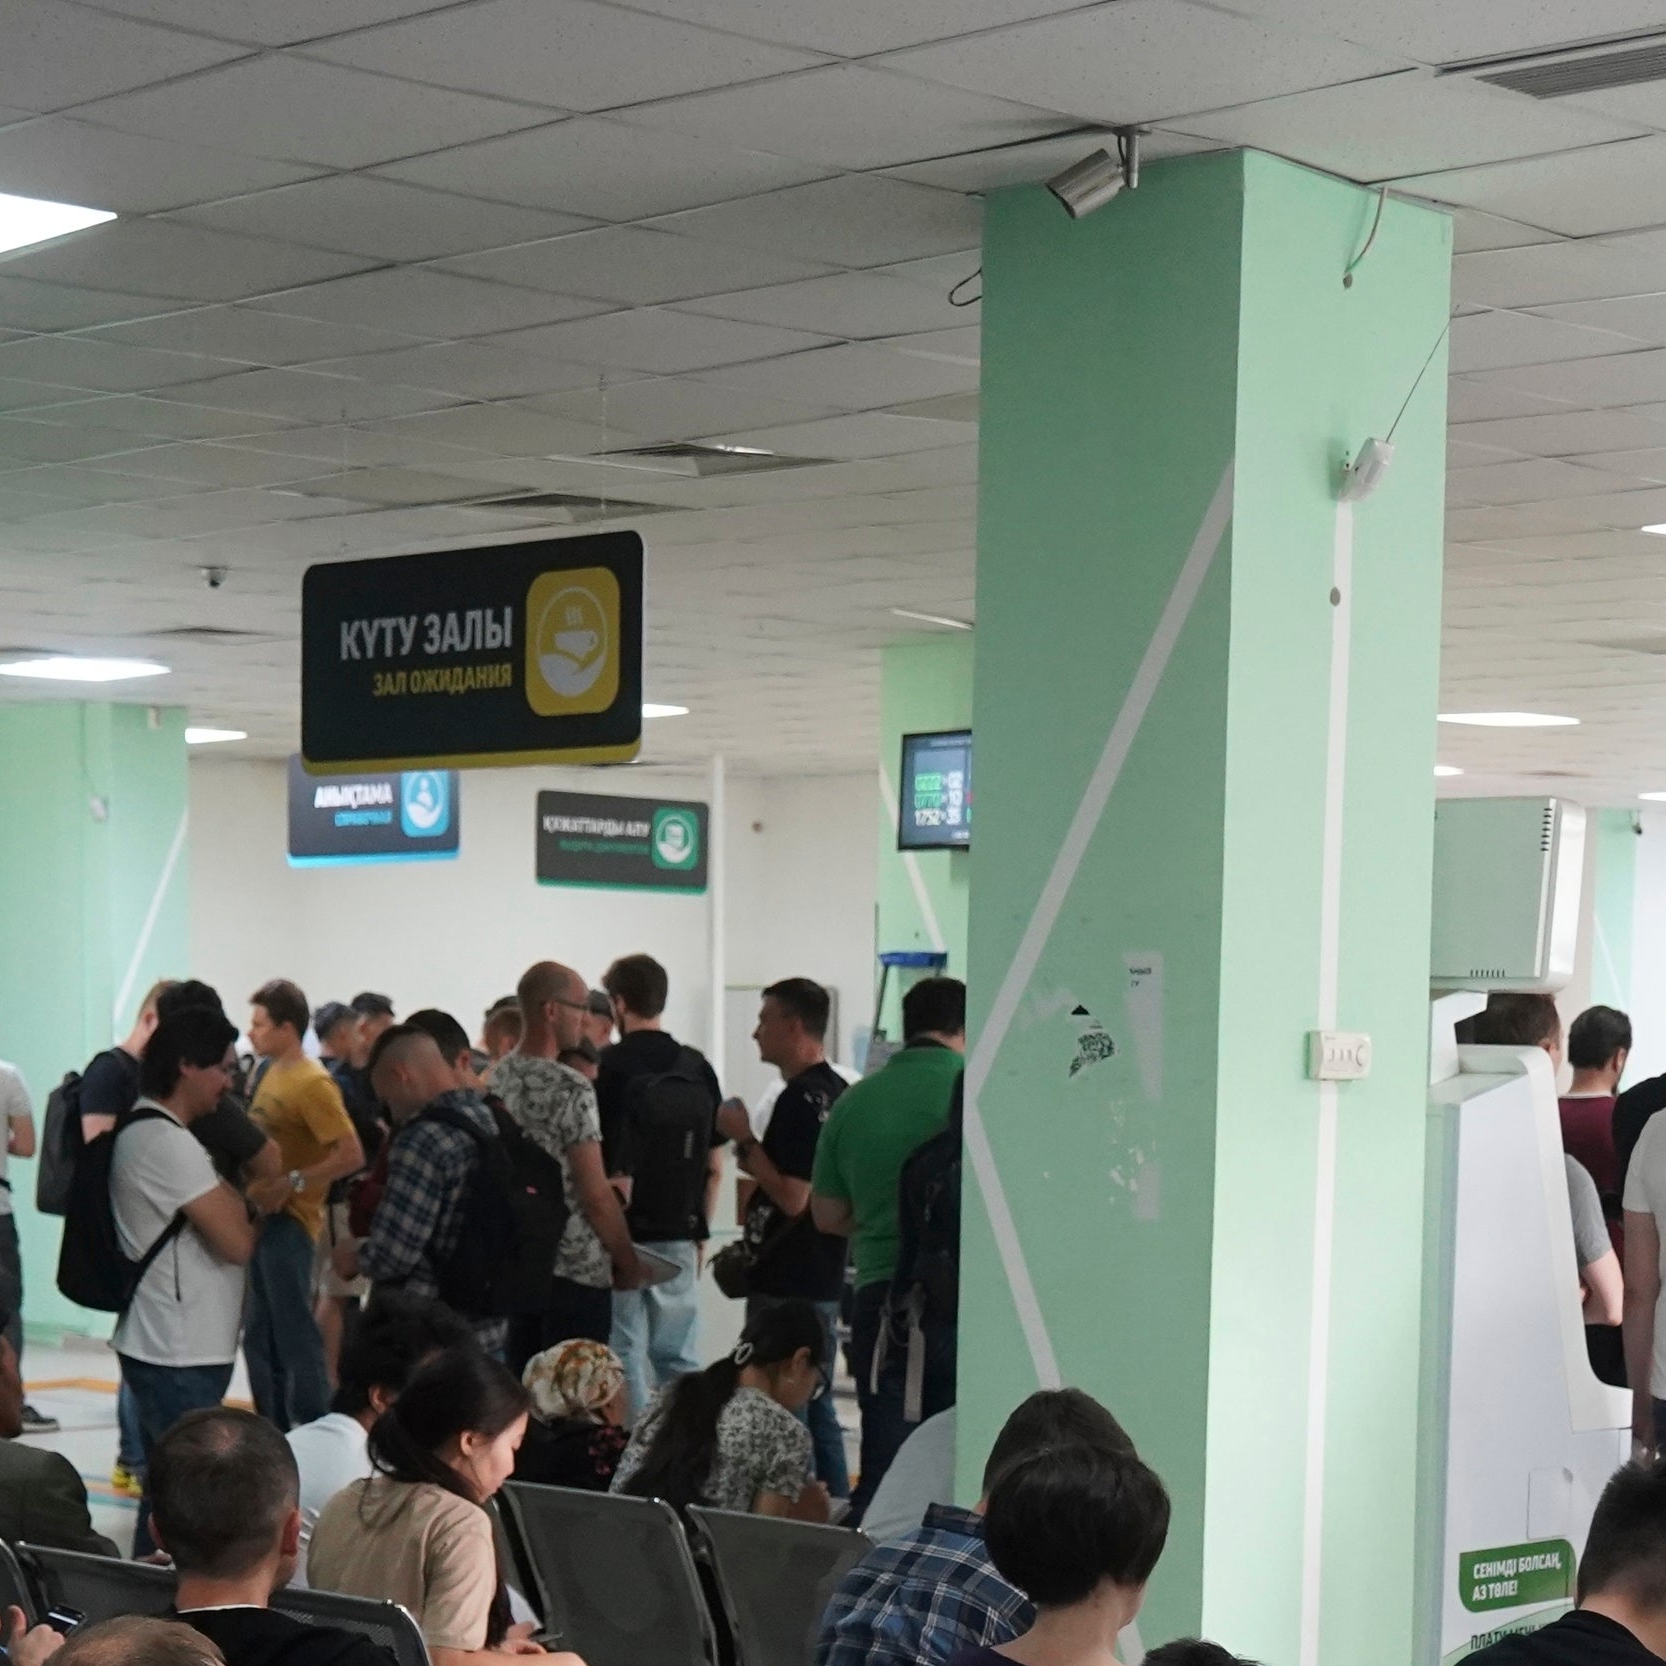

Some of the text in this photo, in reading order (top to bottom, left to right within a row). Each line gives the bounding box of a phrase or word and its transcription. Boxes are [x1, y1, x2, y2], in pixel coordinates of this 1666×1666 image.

[340, 606, 513, 660] КҮТУ ЗАЛЫ
[373, 664, 512, 696] ЗАЛ ОЖИДАНИЯ
[1473, 1558, 1517, 1579] СЕНІМДІ
[1472, 1584, 1486, 1601] АЗ
